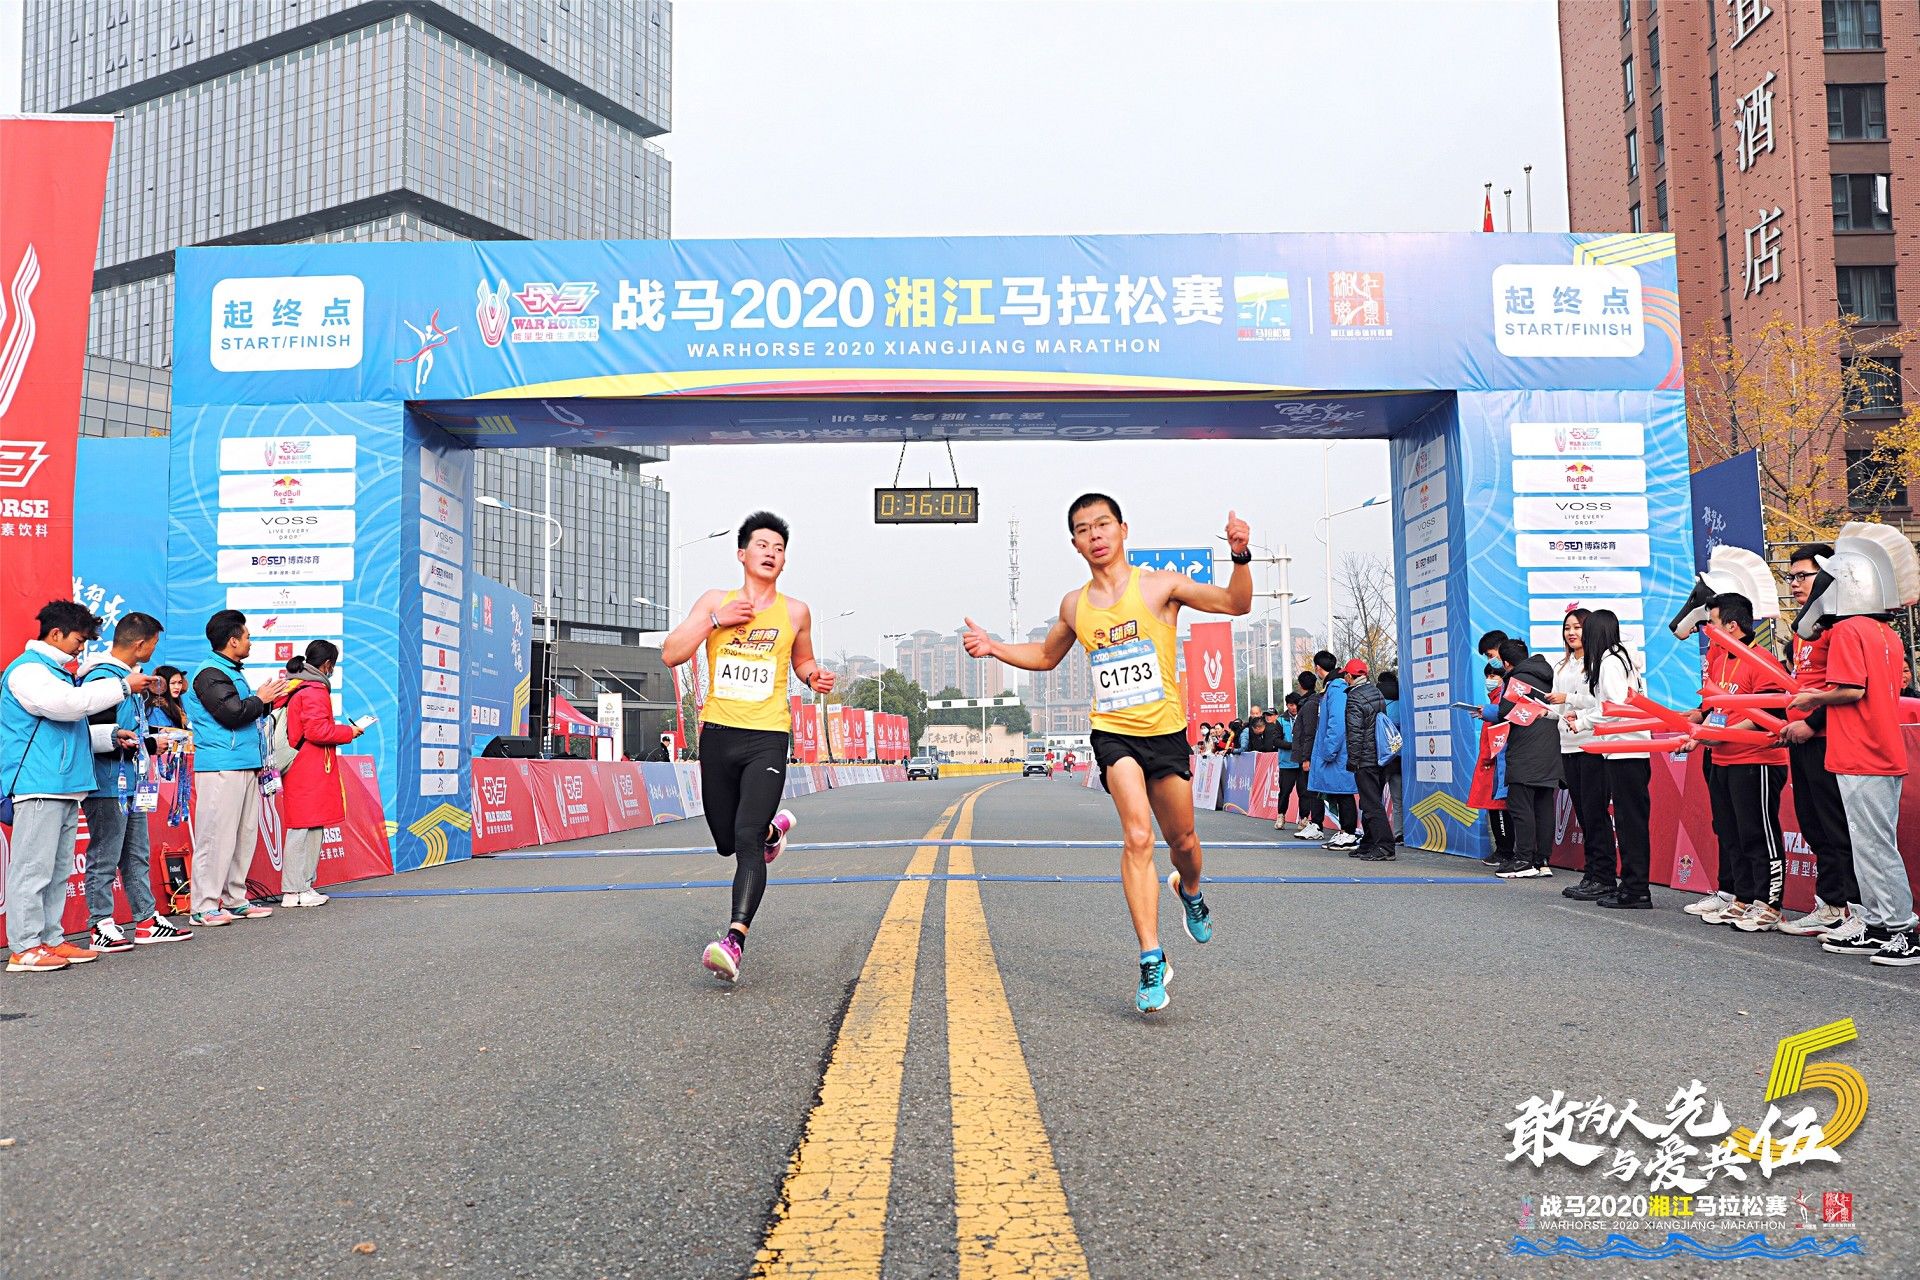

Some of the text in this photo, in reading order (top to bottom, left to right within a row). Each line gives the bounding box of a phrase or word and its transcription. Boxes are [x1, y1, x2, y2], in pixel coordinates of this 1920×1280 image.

[612, 274, 1225, 332] 战马2020湘江马拉松赛
[1505, 285, 1630, 315] 起终点
[223, 298, 351, 329] 起终点
[513, 317, 597, 330] WAR HORSE
[1505, 323, 1632, 336] START/FINISH
[221, 335, 350, 350] START/FINISH
[686, 338, 1161, 358] WARHORSE 2020 XIANGJIANG MARATHON
[0, 499, 48, 518] RSE
[881, 494, 972, 516] 0:36:00
[1555, 502, 1612, 511] VOSS
[260, 516, 318, 525] VOSS
[1549, 541, 1583, 551] BOSEN
[251, 556, 286, 566] BOSEN
[721, 664, 769, 684] A1013
[1100, 663, 1153, 688] C1733
